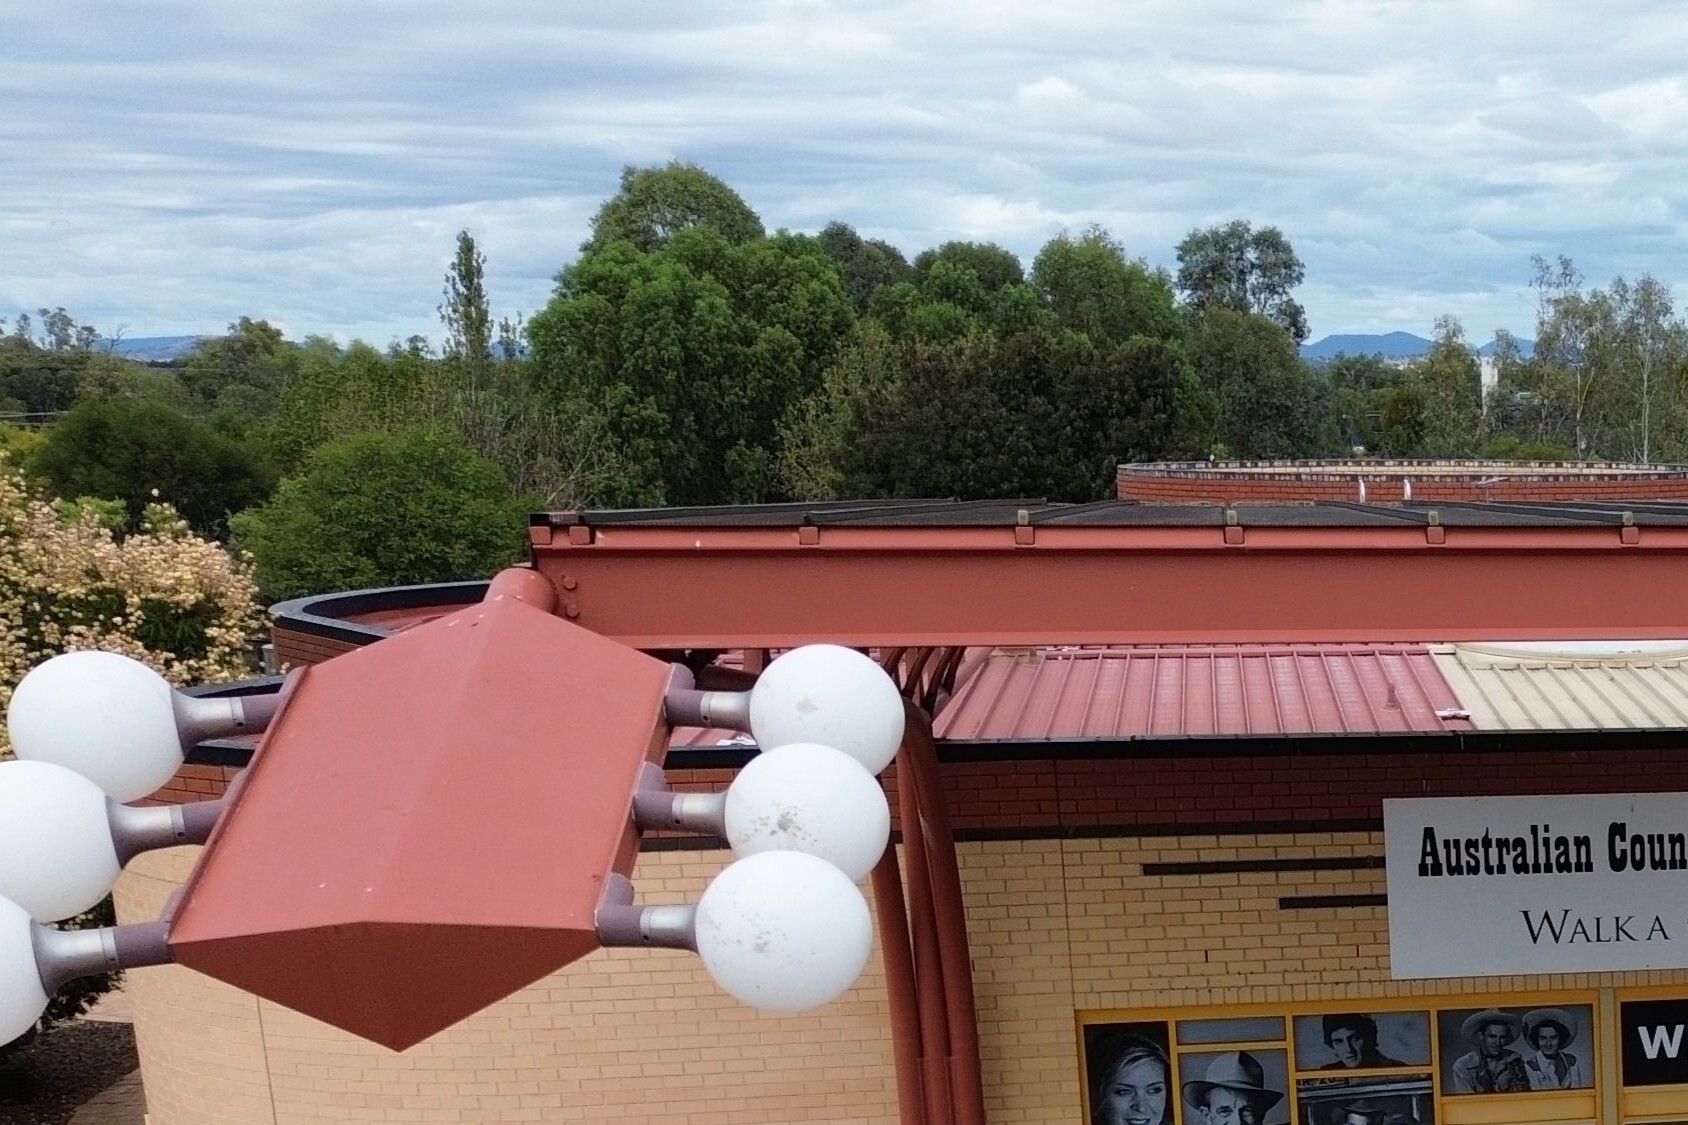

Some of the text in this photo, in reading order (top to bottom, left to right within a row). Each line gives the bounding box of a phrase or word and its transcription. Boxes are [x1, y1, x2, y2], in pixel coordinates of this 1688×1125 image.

[1418, 824, 1594, 877] Australian
[1520, 909, 1639, 944] WALK
[1646, 915, 1671, 941] A
